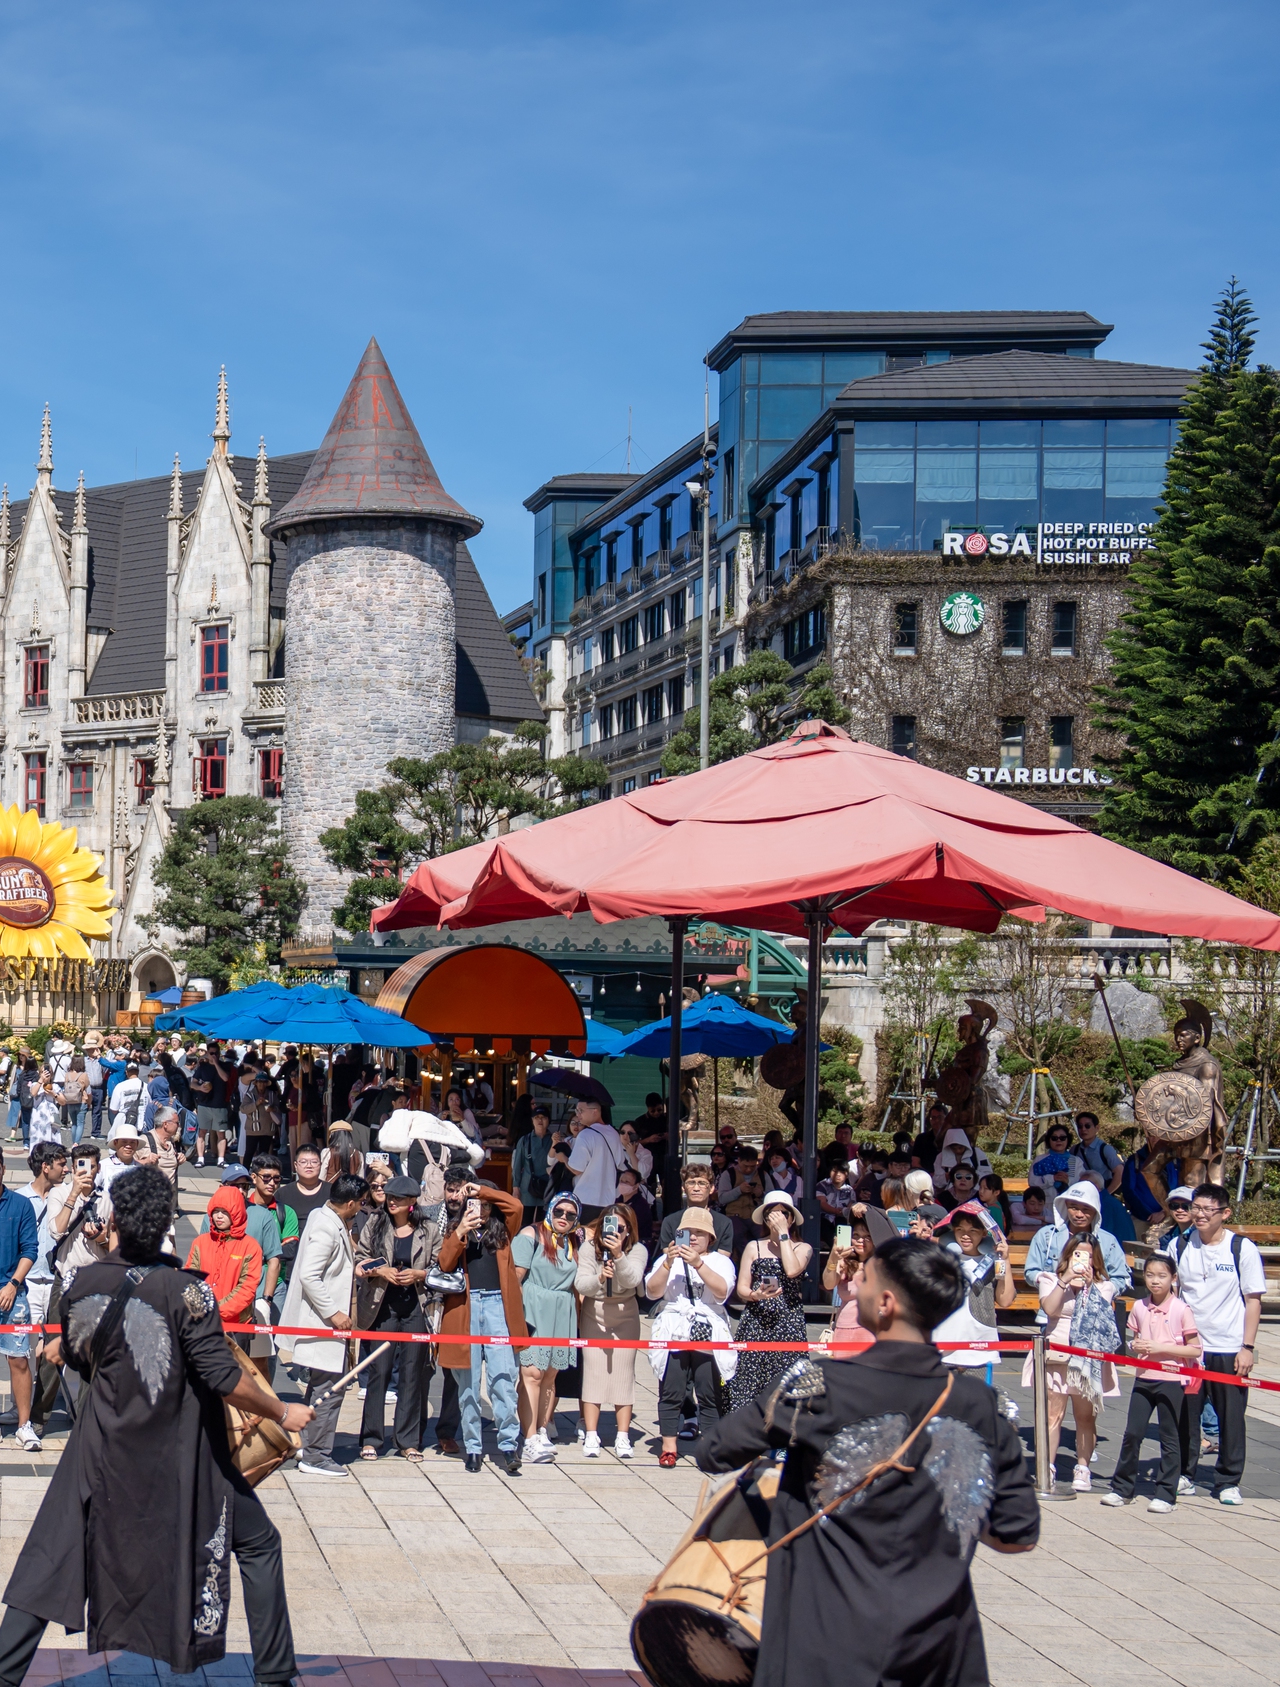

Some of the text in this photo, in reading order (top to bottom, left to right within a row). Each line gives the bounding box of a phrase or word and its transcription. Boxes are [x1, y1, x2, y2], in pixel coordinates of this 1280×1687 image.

[1043, 522, 1084, 534] DEEP
[1088, 522, 1134, 534] FRIED
[943, 532, 1033, 556] ROSA
[1042, 537, 1073, 549] HOT
[1076, 537, 1106, 549] POT
[1043, 552, 1131, 564] SUSHI BAR
[1215, 1263, 1234, 1272] VANS
